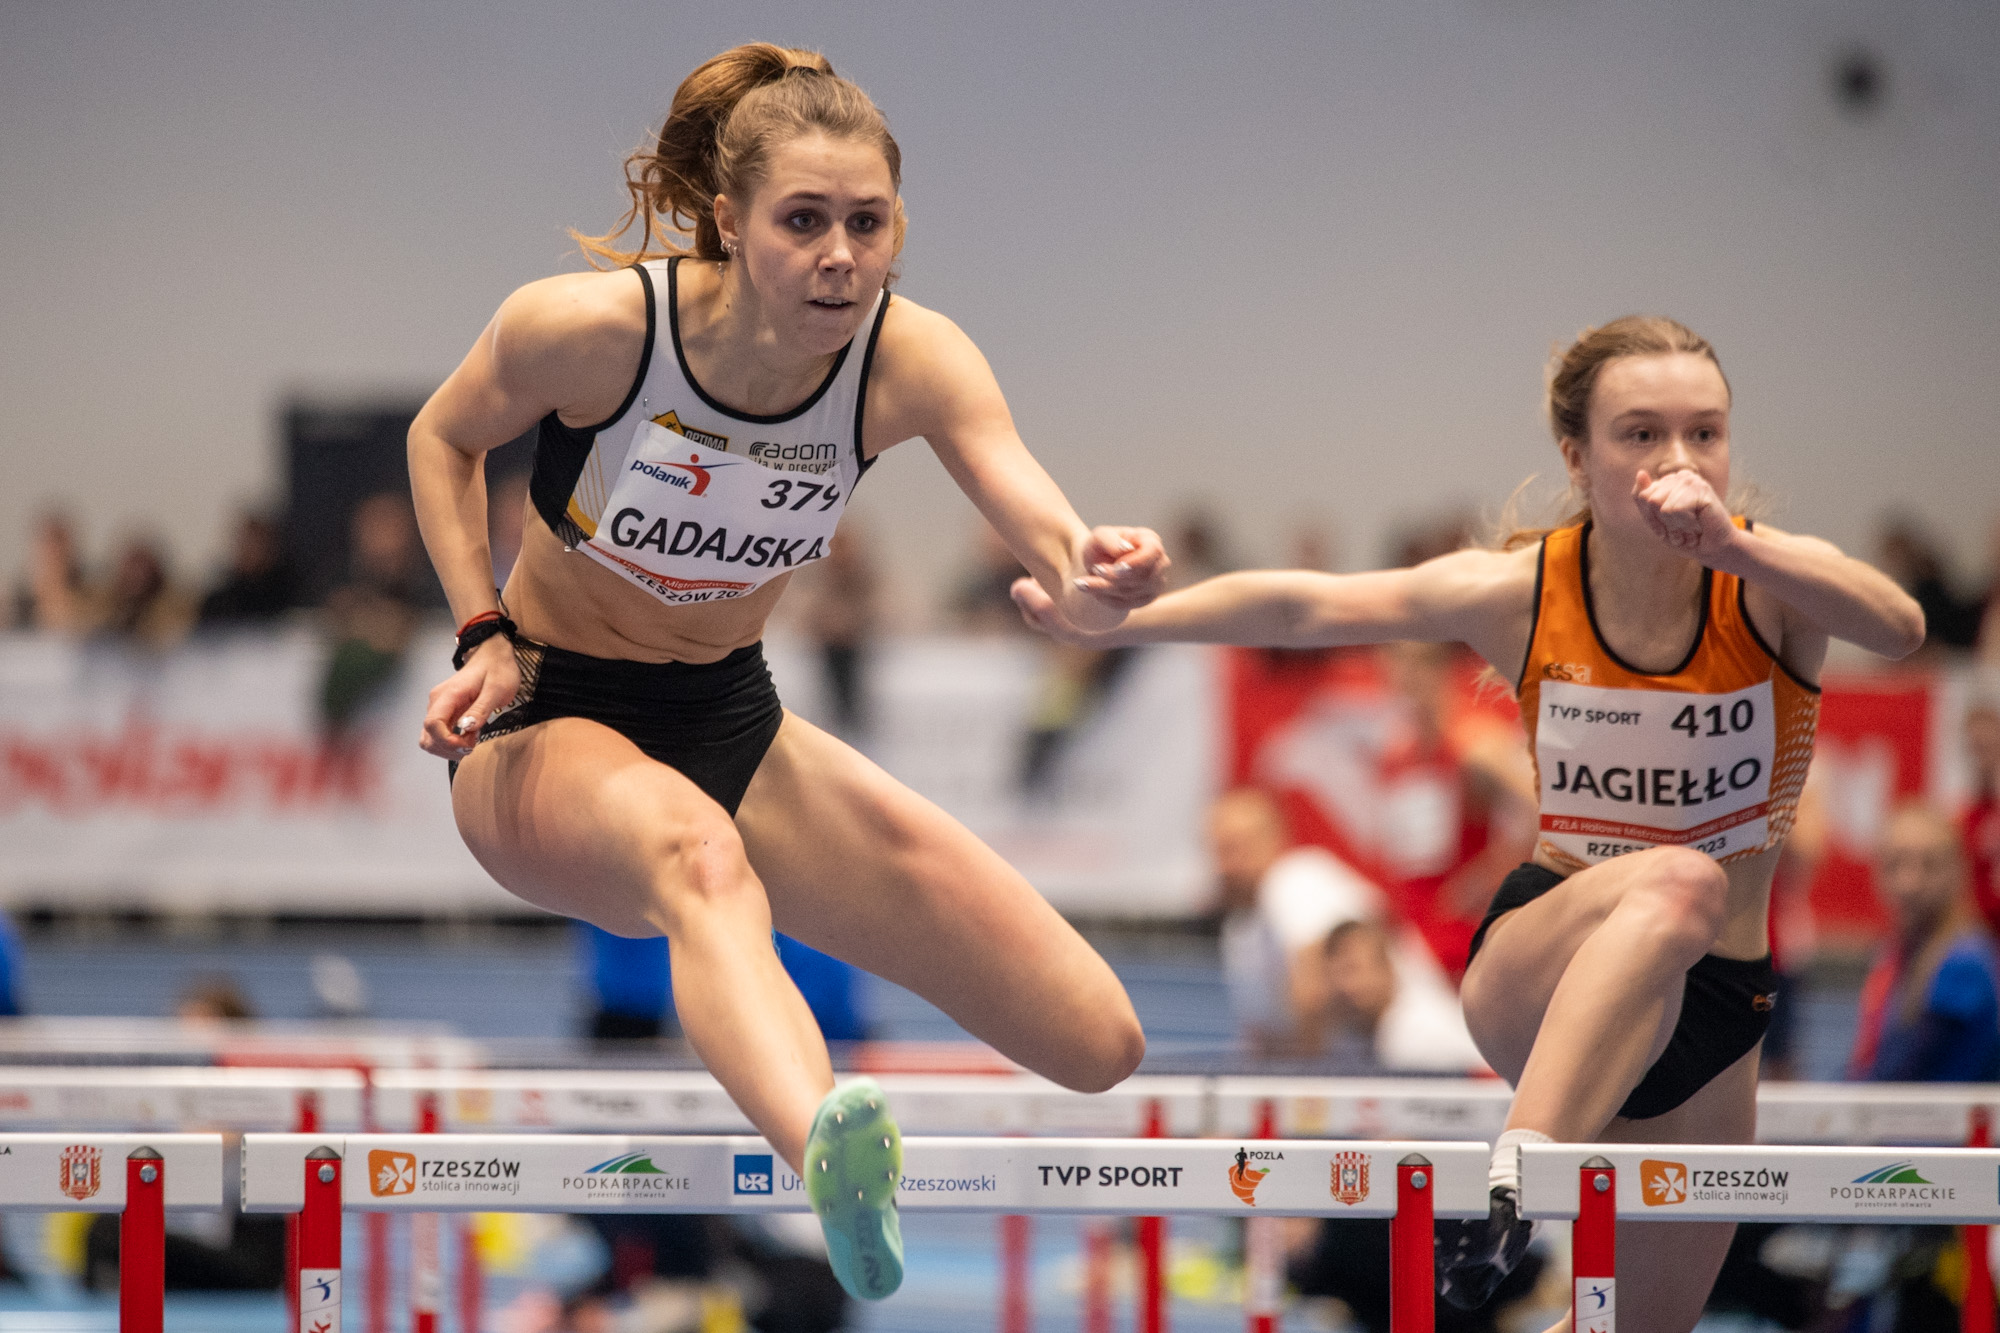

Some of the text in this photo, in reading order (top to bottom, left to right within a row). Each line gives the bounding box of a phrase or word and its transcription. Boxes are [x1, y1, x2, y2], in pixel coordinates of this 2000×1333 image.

[630, 460, 692, 490] polanik
[774, 463, 784, 471] w
[760, 479, 841, 512] 379
[610, 507, 823, 569] GADAJSKA
[1549, 704, 1641, 726] TVP SPORT
[1671, 699, 1755, 739] 410
[1551, 758, 1762, 807] JAGIEŁŁO
[1697, 836, 1727, 854] 023
[1249, 1150, 1285, 1161] POZLA
[422, 1158, 520, 1178] rzeszów
[1037, 1165, 1183, 1187] TVP SPORT
[1692, 1168, 1789, 1187] rzeszów
[422, 1179, 520, 1196] stolica innowacji
[562, 1177, 690, 1190] PODKARPACKIE
[1692, 1188, 1789, 1205] stolica innowacji
[1830, 1187, 1956, 1200] PODKARPACKIE
